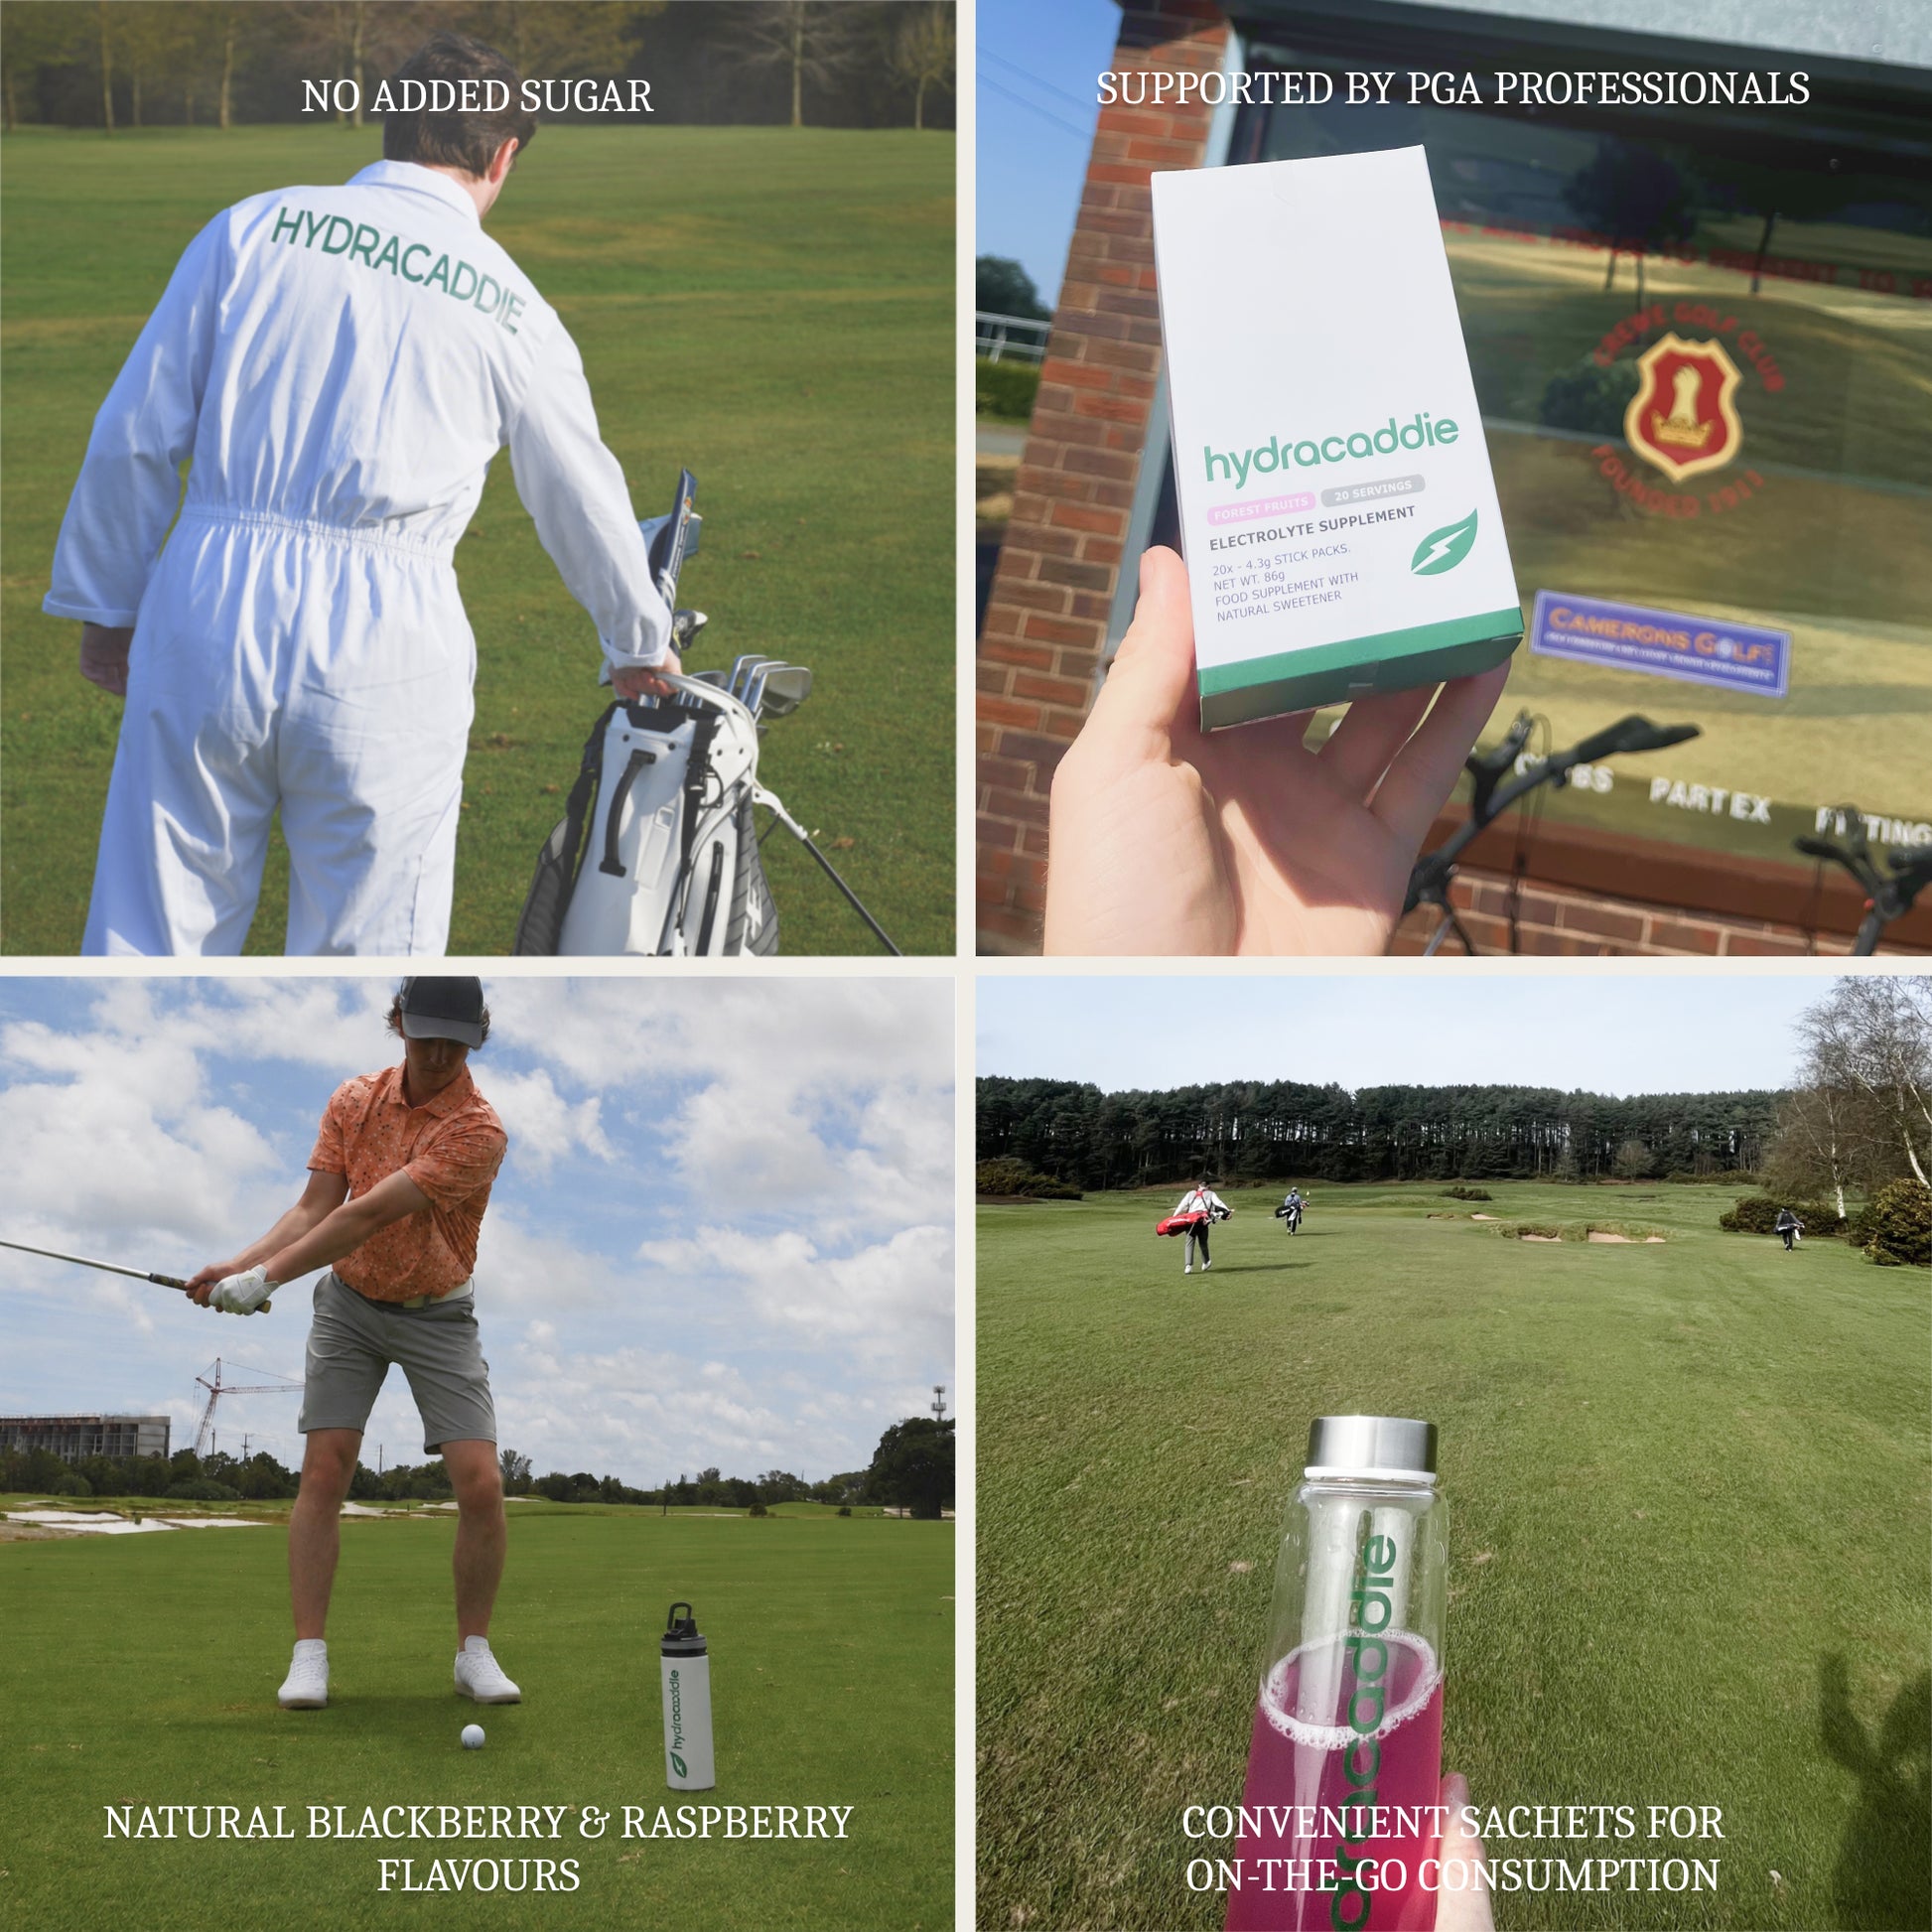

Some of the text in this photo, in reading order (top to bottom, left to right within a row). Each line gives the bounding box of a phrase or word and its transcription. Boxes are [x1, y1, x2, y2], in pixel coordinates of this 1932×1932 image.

[271, 206, 527, 337] HYDRACADDIE
[1674, 302, 1738, 333] GOLF
[1738, 330, 1786, 392] CLUB
[1203, 412, 1459, 489] hydracaddie
[1214, 496, 1310, 520] FOREST FRUITS
[1334, 480, 1413, 502] 20 SERVINGS
[1209, 505, 1416, 551] ELECTROLYTE SUPPLEMENT
[1212, 565, 1234, 576] 20x
[1245, 558, 1272, 570] 4.3g
[1274, 551, 1309, 565] STICK
[1311, 543, 1351, 558] PACKS.
[1213, 571, 1286, 591] NET WT. 86g
[1215, 572, 1359, 607] FOOD SUPPLEMENT WITH
[1217, 590, 1342, 622] NATURAL SWEETENER
[1549, 607, 1691, 652] CAMERONS
